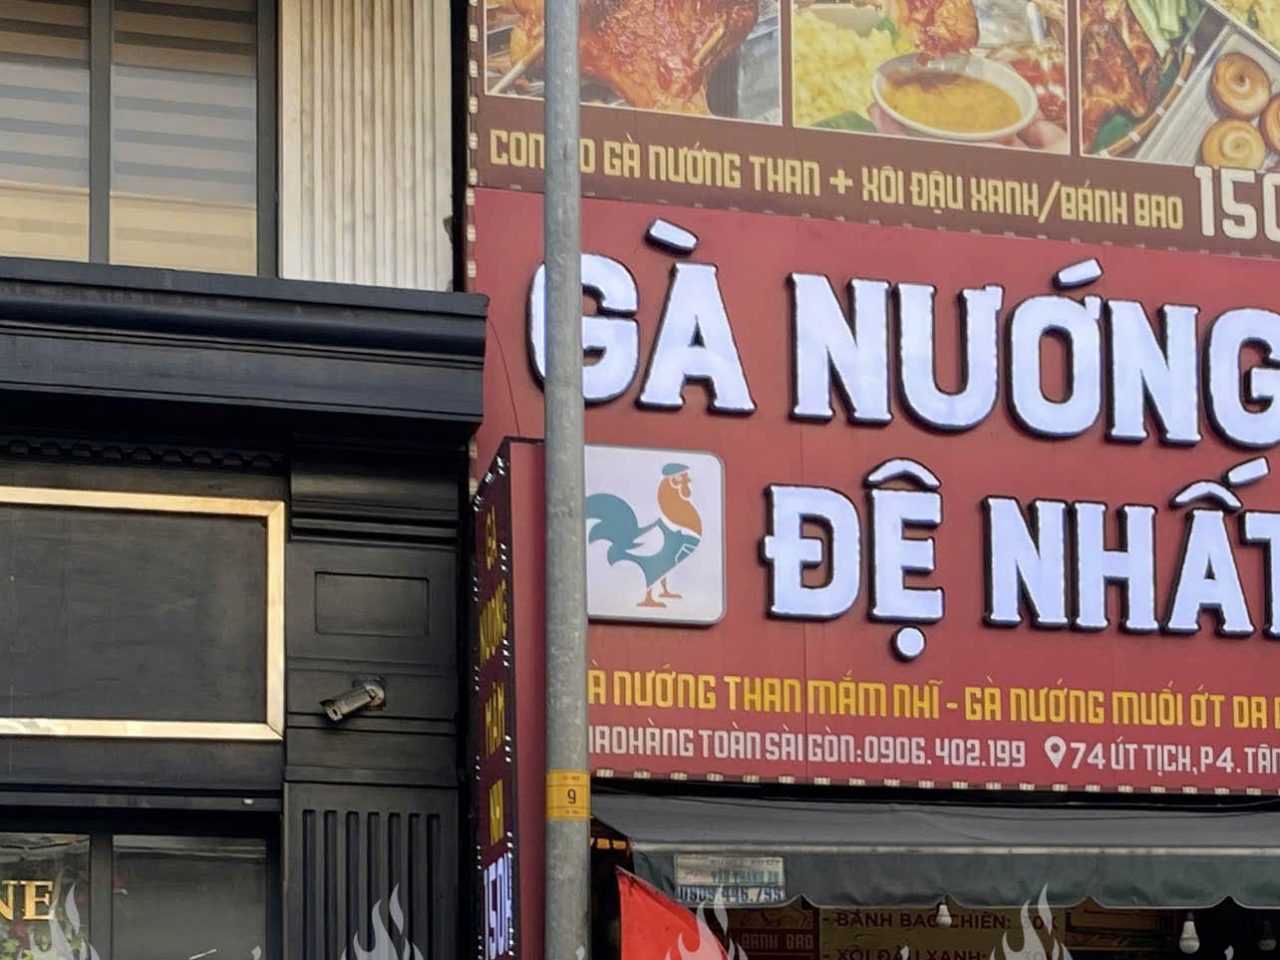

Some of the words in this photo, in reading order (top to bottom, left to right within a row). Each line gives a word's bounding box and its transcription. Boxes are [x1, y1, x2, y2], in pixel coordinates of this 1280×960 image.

[604, 133, 640, 178] GÀ
[649, 141, 741, 189] NƯỚNG
[749, 155, 821, 197] THAN
[829, 168, 854, 195] +
[861, 166, 904, 204] XÔI
[910, 171, 963, 215] ĐẬU
[1134, 191, 1184, 230] BAO
[528, 218, 756, 416] GÀ
[763, 457, 947, 663] ĐỆ
[588, 659, 606, 705] À
[613, 663, 717, 710] NƯỚNG
[723, 675, 802, 714] THAN
[808, 670, 886, 718] MẮM
[893, 679, 944, 719] NHĨ
[965, 675, 1002, 721] GÀ
[1010, 678, 1105, 725] NƯỚNG
[1111, 680, 1184, 727] MUỐI
[1190, 684, 1226, 728] ỚT
[1232, 695, 1268, 730] DA
[698, 721, 762, 760] TOÀN
[765, 723, 803, 761] SÀI
[1070, 742, 1106, 770] 74
[1111, 737, 1139, 771] ÚT
[567, 788, 577, 805] 9
